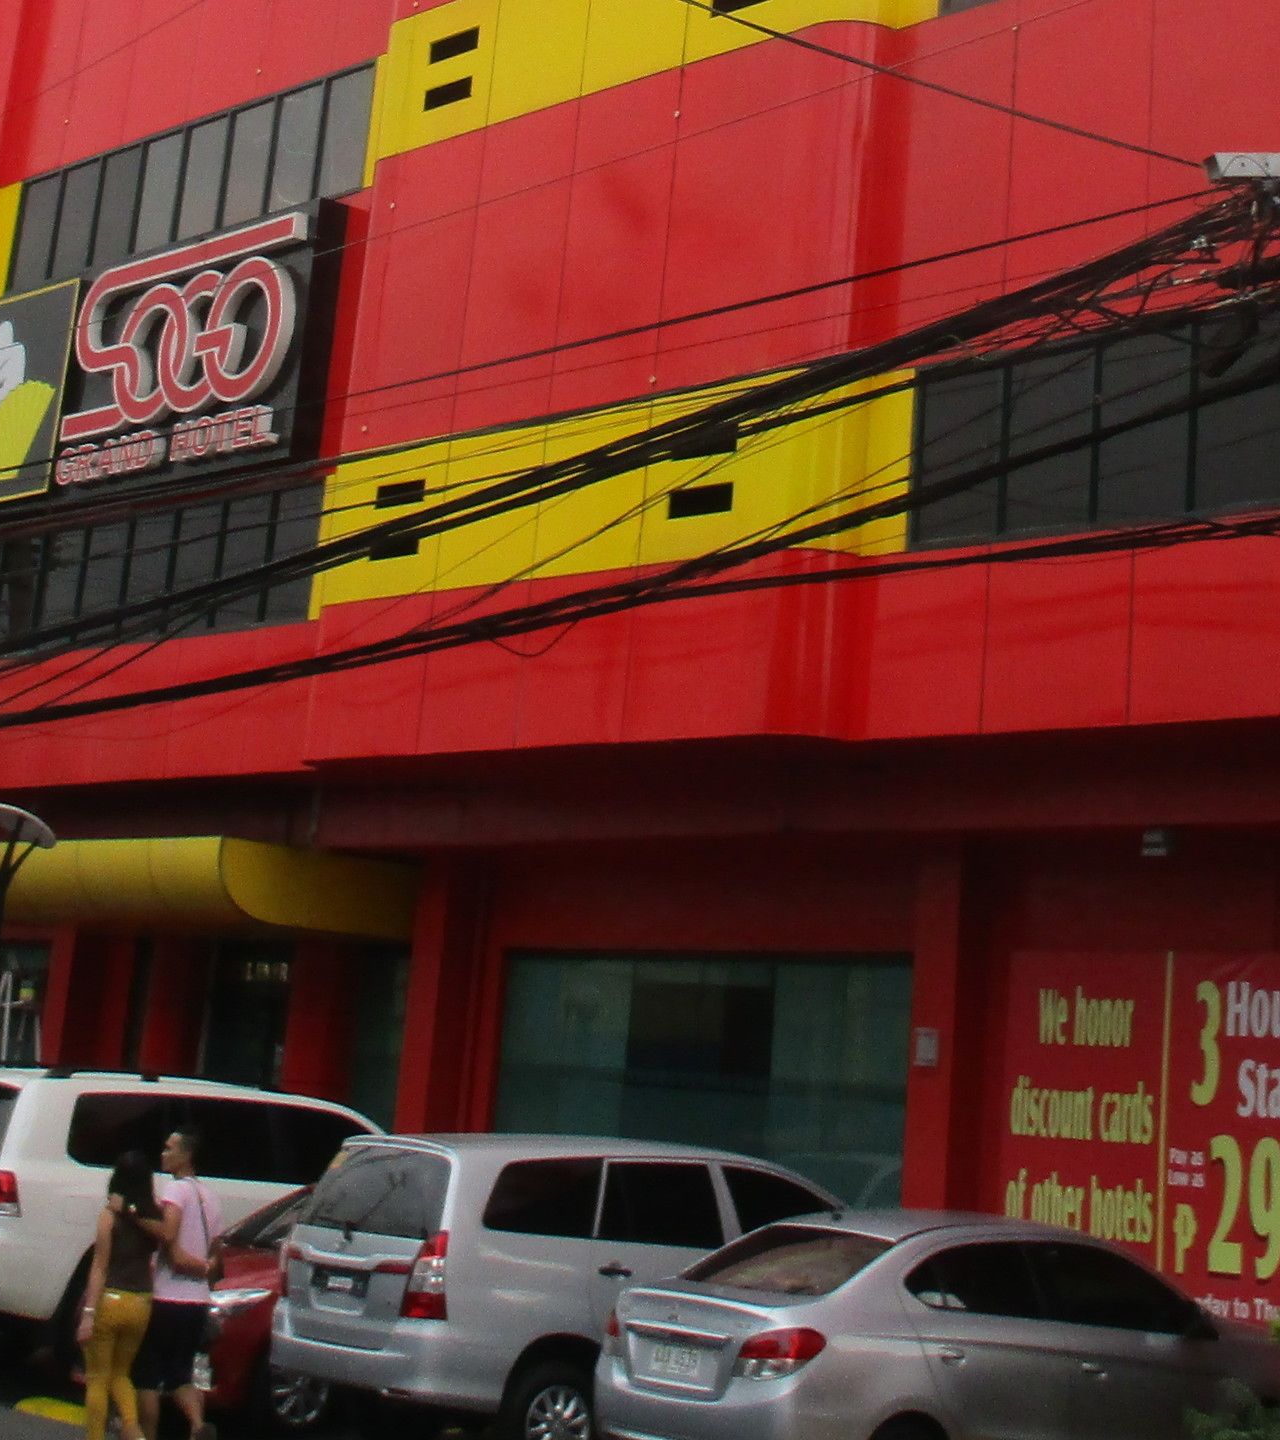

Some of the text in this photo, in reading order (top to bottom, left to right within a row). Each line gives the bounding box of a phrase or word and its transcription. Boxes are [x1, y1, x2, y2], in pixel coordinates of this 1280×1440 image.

[60, 212, 310, 442] SOGO
[55, 404, 279, 486] GRAND HOTEL
[1039, 985, 1135, 1048] We honor
[1190, 980, 1221, 1106] 3
[1010, 1074, 1154, 1146] discount cards
[1004, 1167, 1154, 1244] of other hotels
